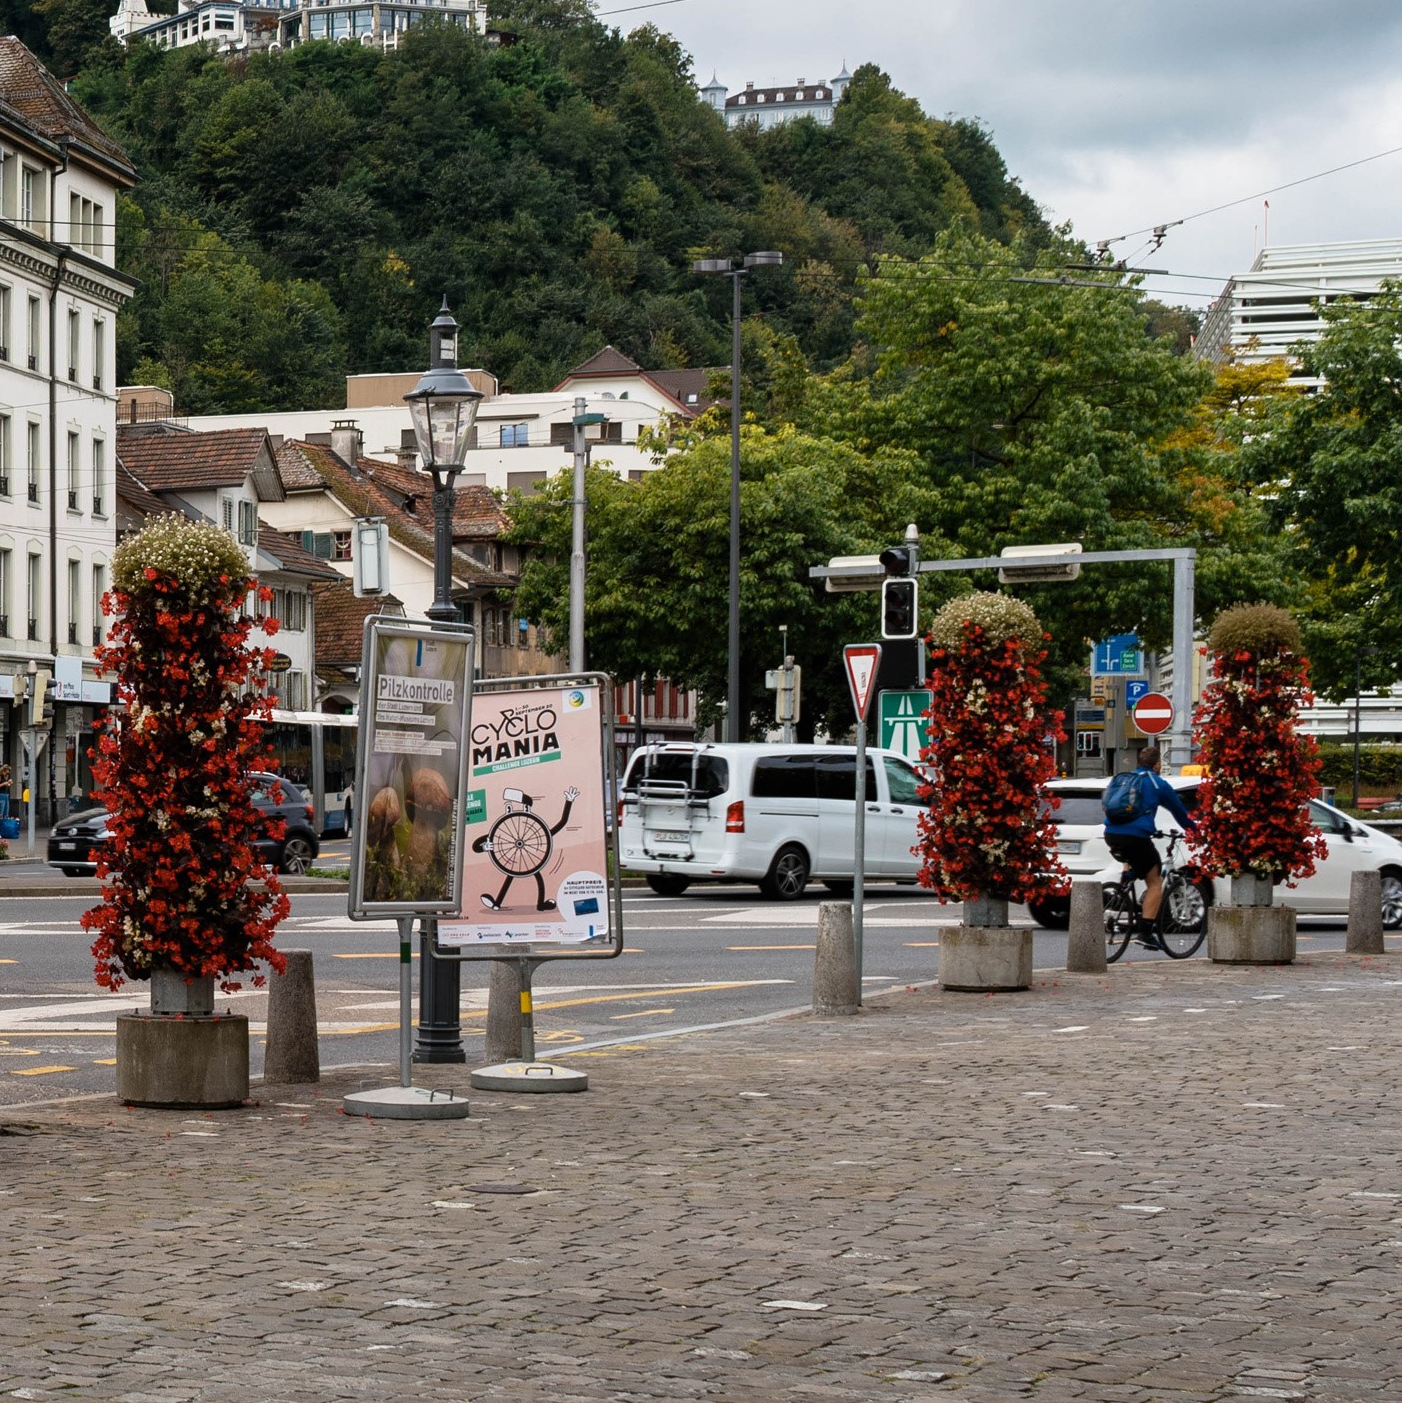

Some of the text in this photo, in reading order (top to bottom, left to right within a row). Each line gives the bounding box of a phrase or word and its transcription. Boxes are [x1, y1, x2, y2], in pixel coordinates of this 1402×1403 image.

[379, 678, 453, 702] Pilzkontrolle
[420, 716, 434, 724] Luzern
[516, 706, 546, 715] SEPTEMBER
[471, 709, 557, 745] CYCLO
[472, 732, 560, 766] MANIA
[492, 757, 540, 772] CHALLENGE LUZERN
[448, 832, 456, 897] NATUR-MUSEUM
